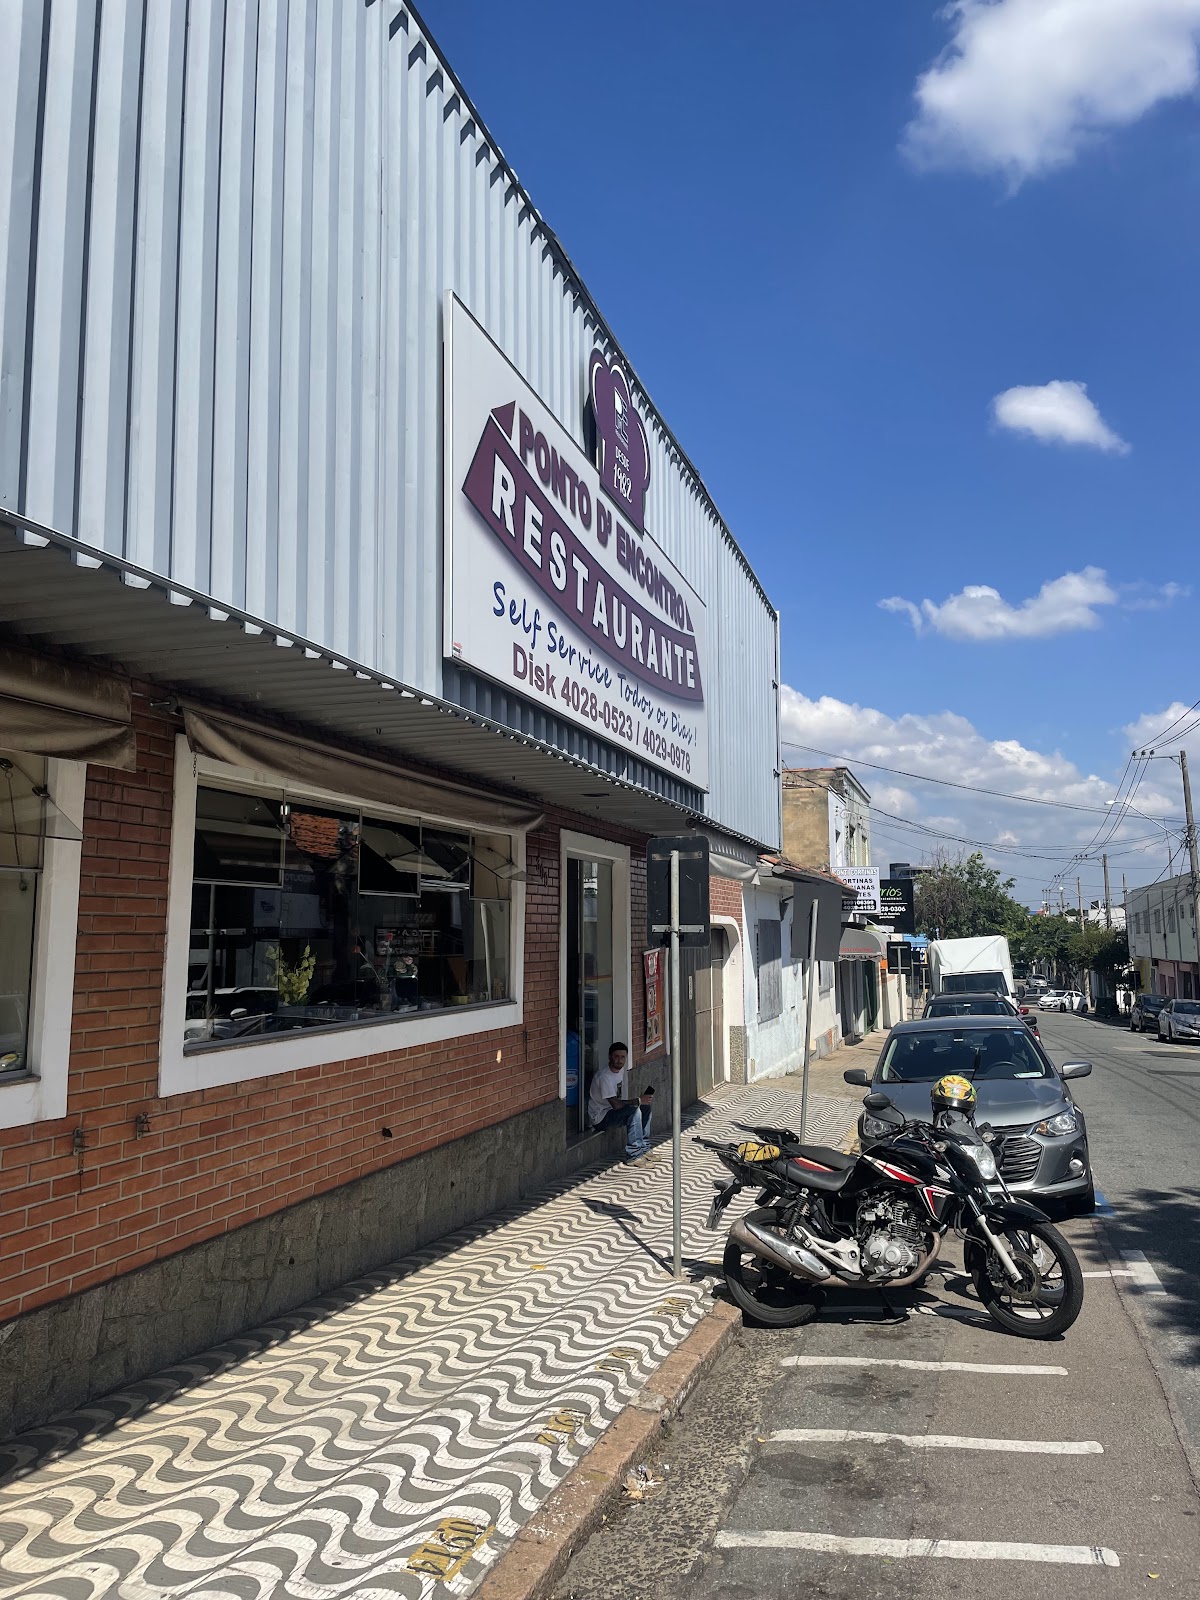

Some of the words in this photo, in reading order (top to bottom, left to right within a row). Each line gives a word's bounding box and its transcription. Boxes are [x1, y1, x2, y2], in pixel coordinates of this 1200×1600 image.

[518, 408, 592, 530] PONTO
[596, 498, 611, 548] D'
[616, 519, 685, 632] ENCONTRO
[613, 463, 633, 503] 1982
[615, 446, 630, 472] DESDE
[492, 453, 696, 690] RESTAURANTE
[492, 581, 542, 650] Self
[547, 621, 612, 689] Service
[617, 672, 653, 720] Todos
[656, 707, 668, 730] os
[512, 641, 557, 700] Disk
[560, 676, 633, 742] 4028-0523
[635, 720, 641, 746] /
[642, 727, 691, 775] 4029-0978
